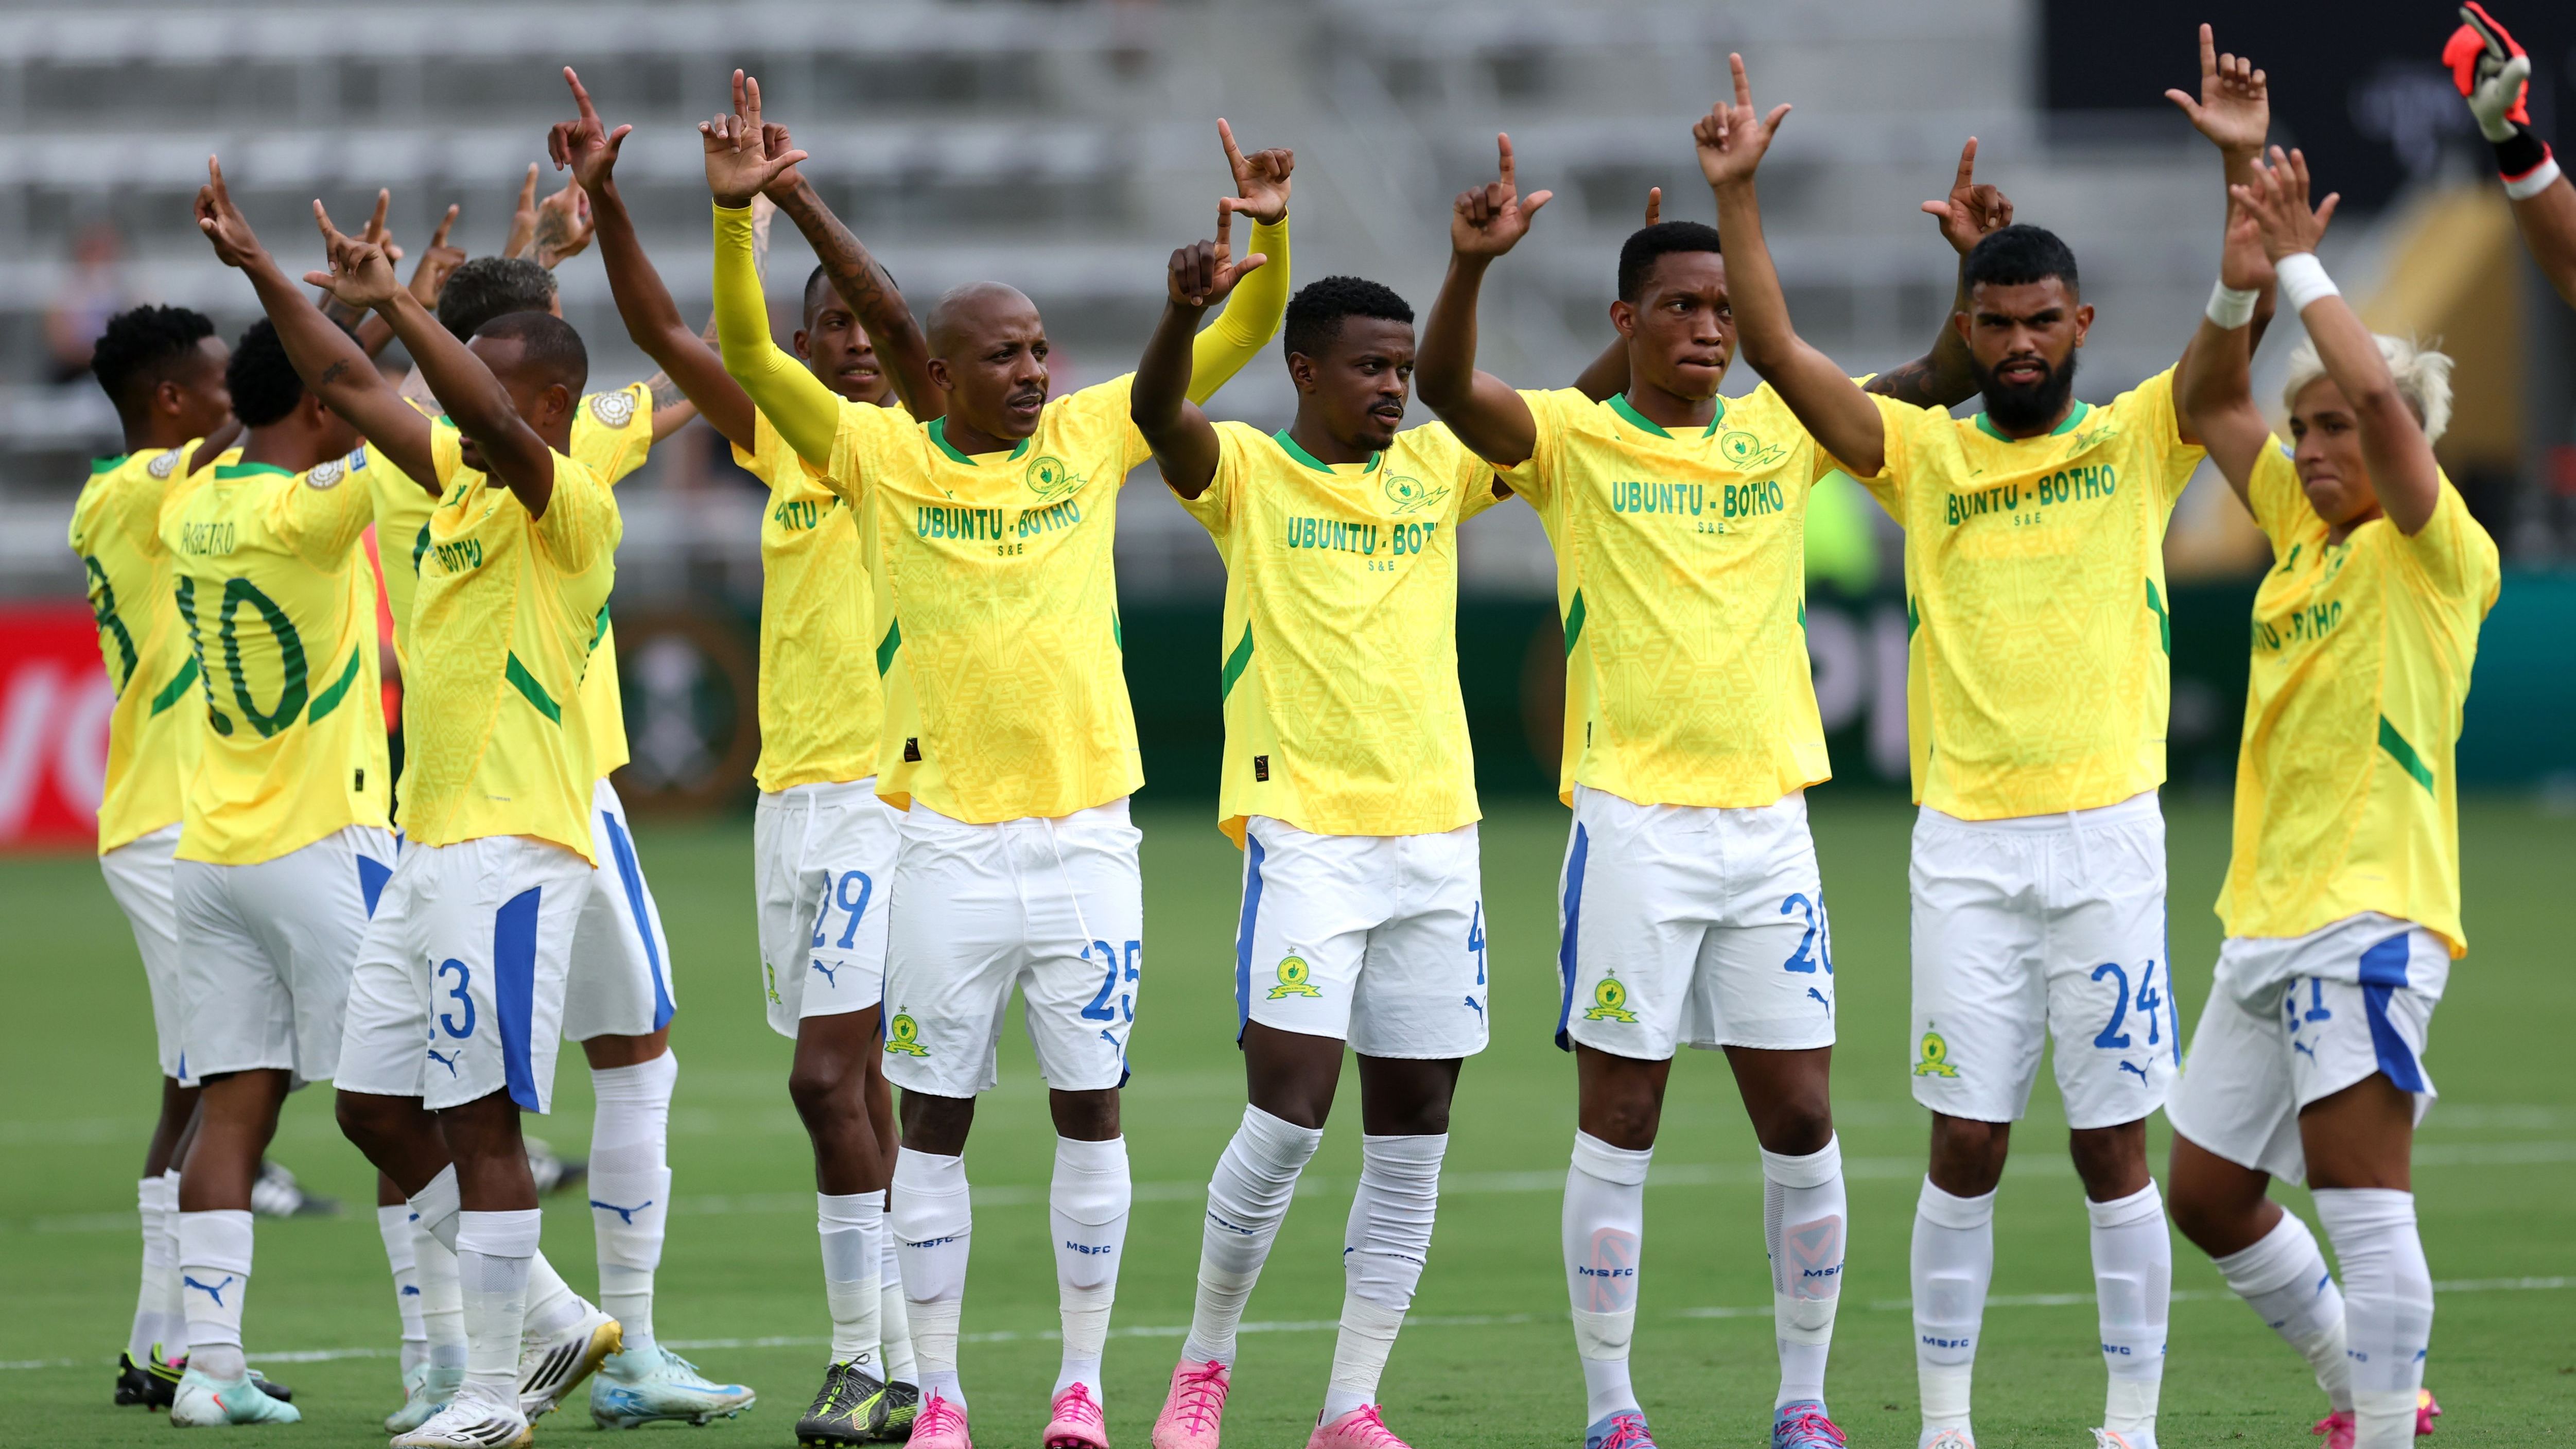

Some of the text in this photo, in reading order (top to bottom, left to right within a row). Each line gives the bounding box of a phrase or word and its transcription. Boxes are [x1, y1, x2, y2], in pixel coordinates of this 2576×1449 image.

[1613, 481, 1702, 515] UBUNTU
[1724, 480, 1784, 517] BOTHO
[1944, 484, 2019, 526] BUNTU
[2038, 464, 2115, 505] BOTHO
[917, 507, 1002, 540] UBUNTU
[1018, 498, 1080, 537] BOTHO
[1287, 517, 1377, 555] UBUNTU
[437, 538, 482, 572] BOTHO
[175, 576, 308, 739] 10
[811, 870, 872, 949] 29
[1468, 900, 1485, 985] 4
[1081, 940, 1141, 1023] 25
[2091, 959, 2160, 1049] 24
[1067, 1241, 1111, 1255] MSFC
[1579, 1265, 1633, 1278] MSFC
[1923, 1335, 1969, 1348] MSFC
